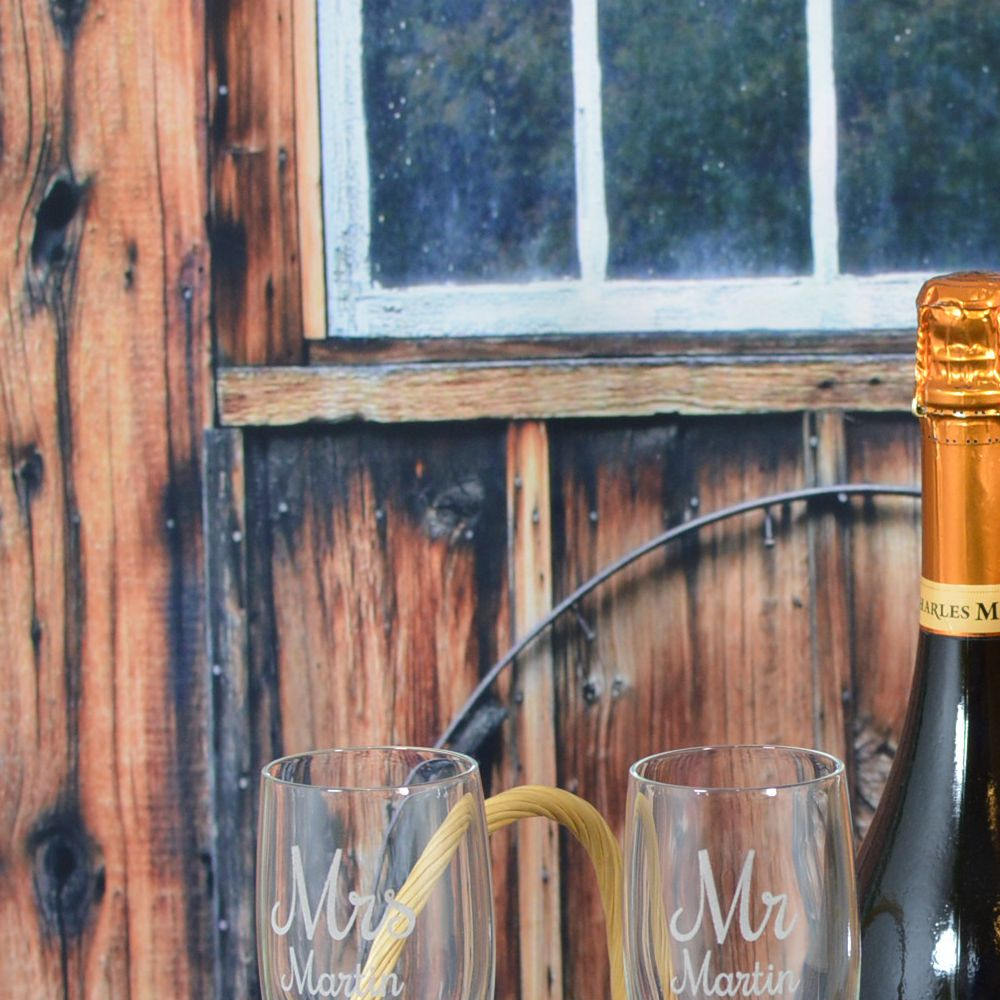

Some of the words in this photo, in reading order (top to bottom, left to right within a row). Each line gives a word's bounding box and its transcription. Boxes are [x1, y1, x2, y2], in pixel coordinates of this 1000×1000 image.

[919, 597, 971, 620] HARLES
[271, 845, 416, 940] Mrs
[669, 848, 798, 944] Mr
[281, 947, 405, 997] Martin
[671, 948, 801, 996] Martin
